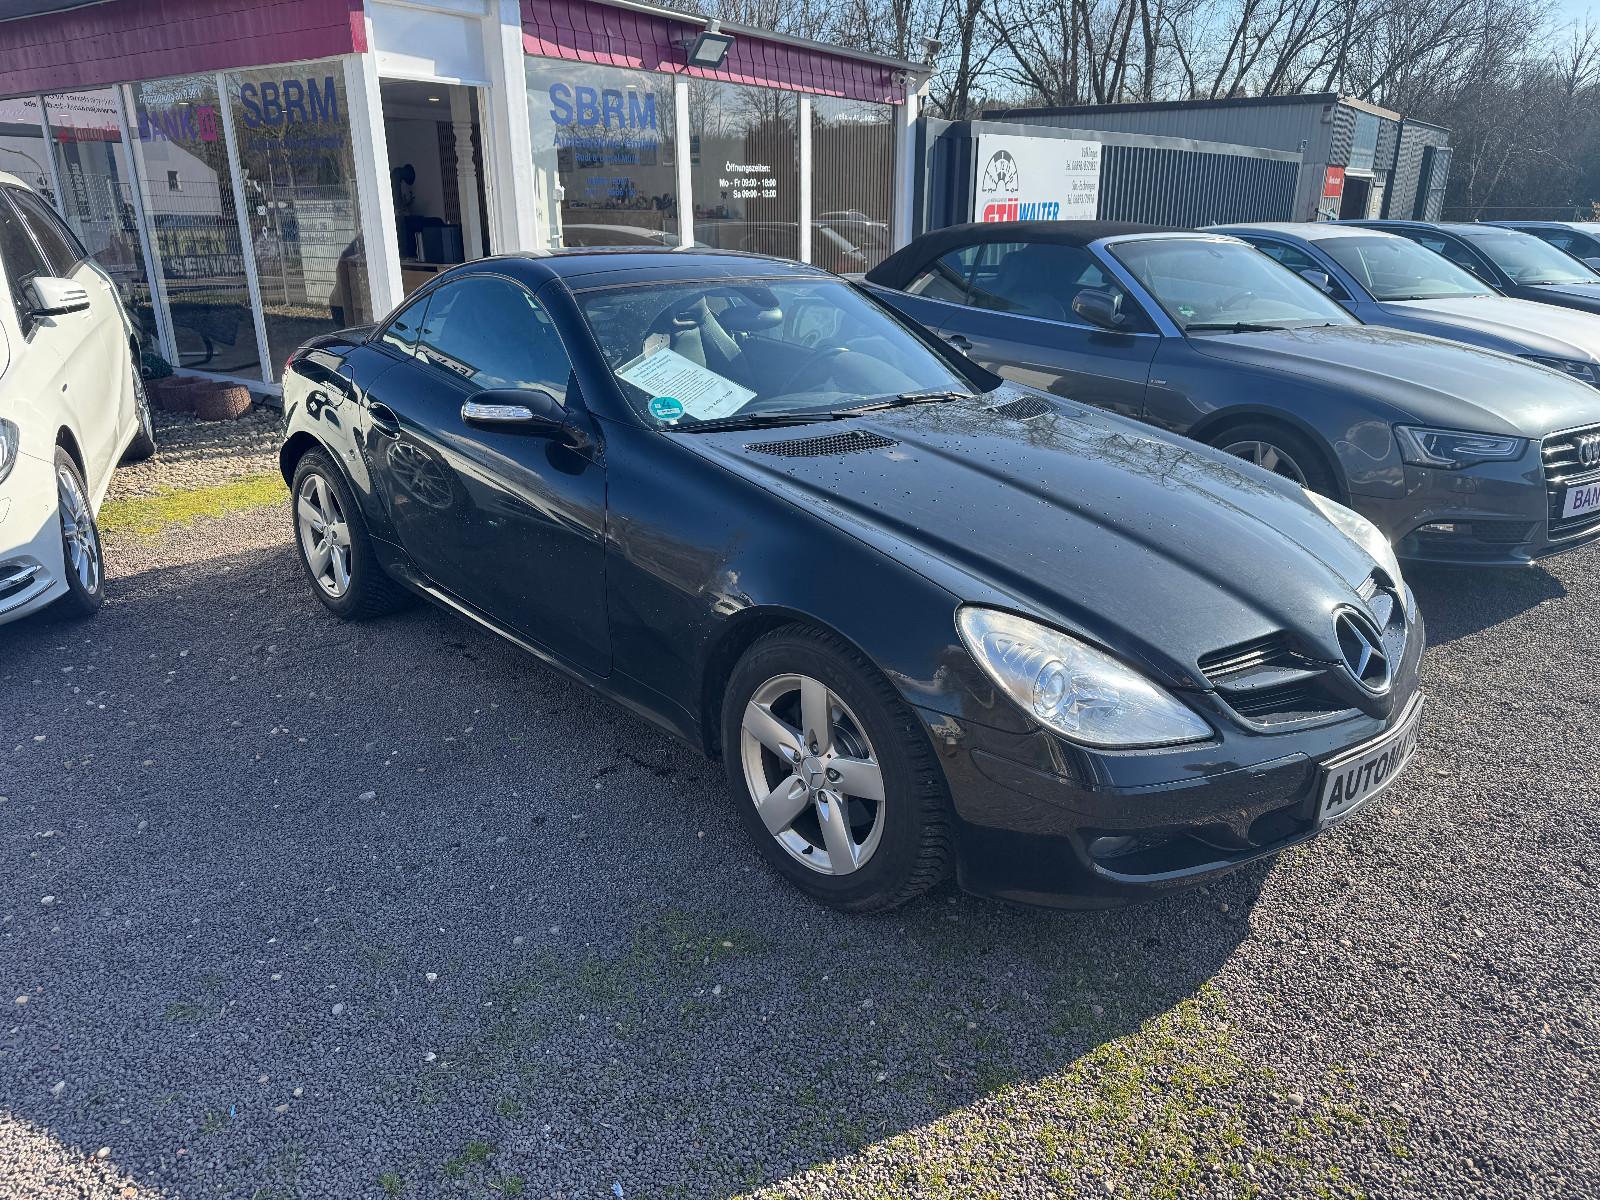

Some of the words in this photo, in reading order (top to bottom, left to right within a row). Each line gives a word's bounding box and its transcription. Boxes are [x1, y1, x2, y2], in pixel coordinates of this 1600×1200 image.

[240, 76, 339, 128] SBRM
[549, 83, 657, 129] SBRM
[137, 106, 196, 142] BANK
[725, 160, 771, 174] Öffnungszeiten:
[719, 178, 730, 188] Mo
[734, 178, 741, 188] Fr
[733, 189, 741, 199] Sa
[983, 197, 1018, 223] GTÜ
